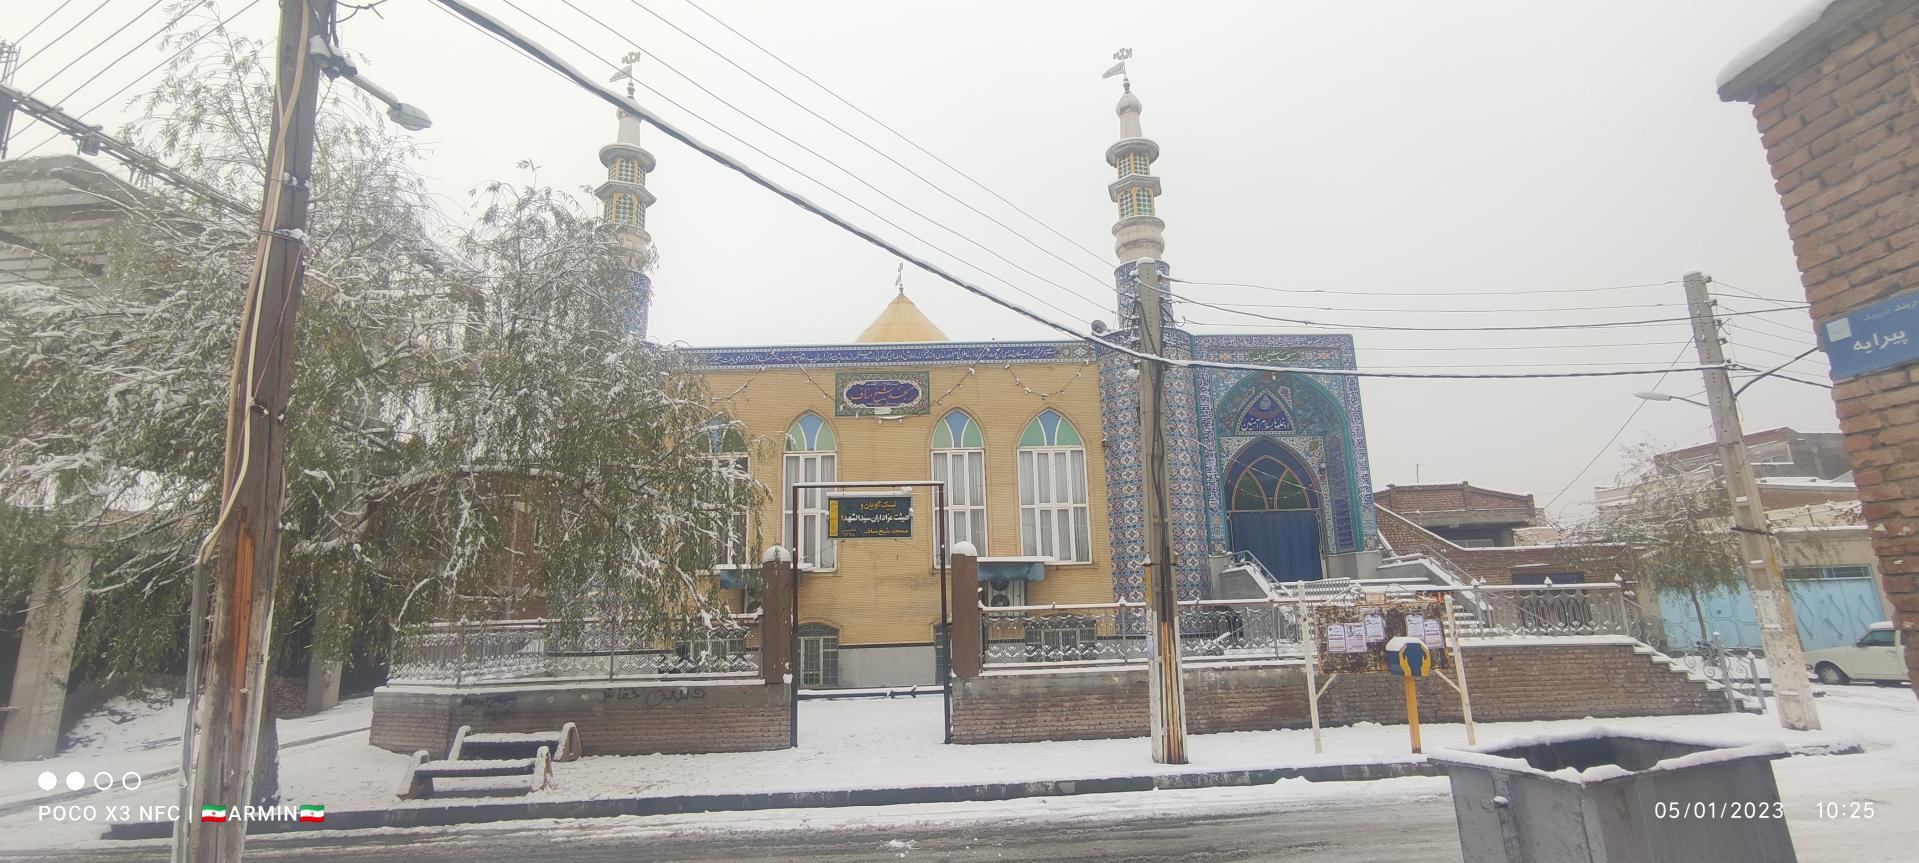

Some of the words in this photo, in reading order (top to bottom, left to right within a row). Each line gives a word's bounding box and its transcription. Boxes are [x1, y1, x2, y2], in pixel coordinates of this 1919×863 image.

[1854, 330, 1909, 354] پیرایه
[864, 500, 881, 511] گویان
[881, 500, 897, 511] لبیک
[870, 512, 894, 523] عزاداران
[863, 527, 878, 535] مناف
[892, 527, 909, 535] مسجد
